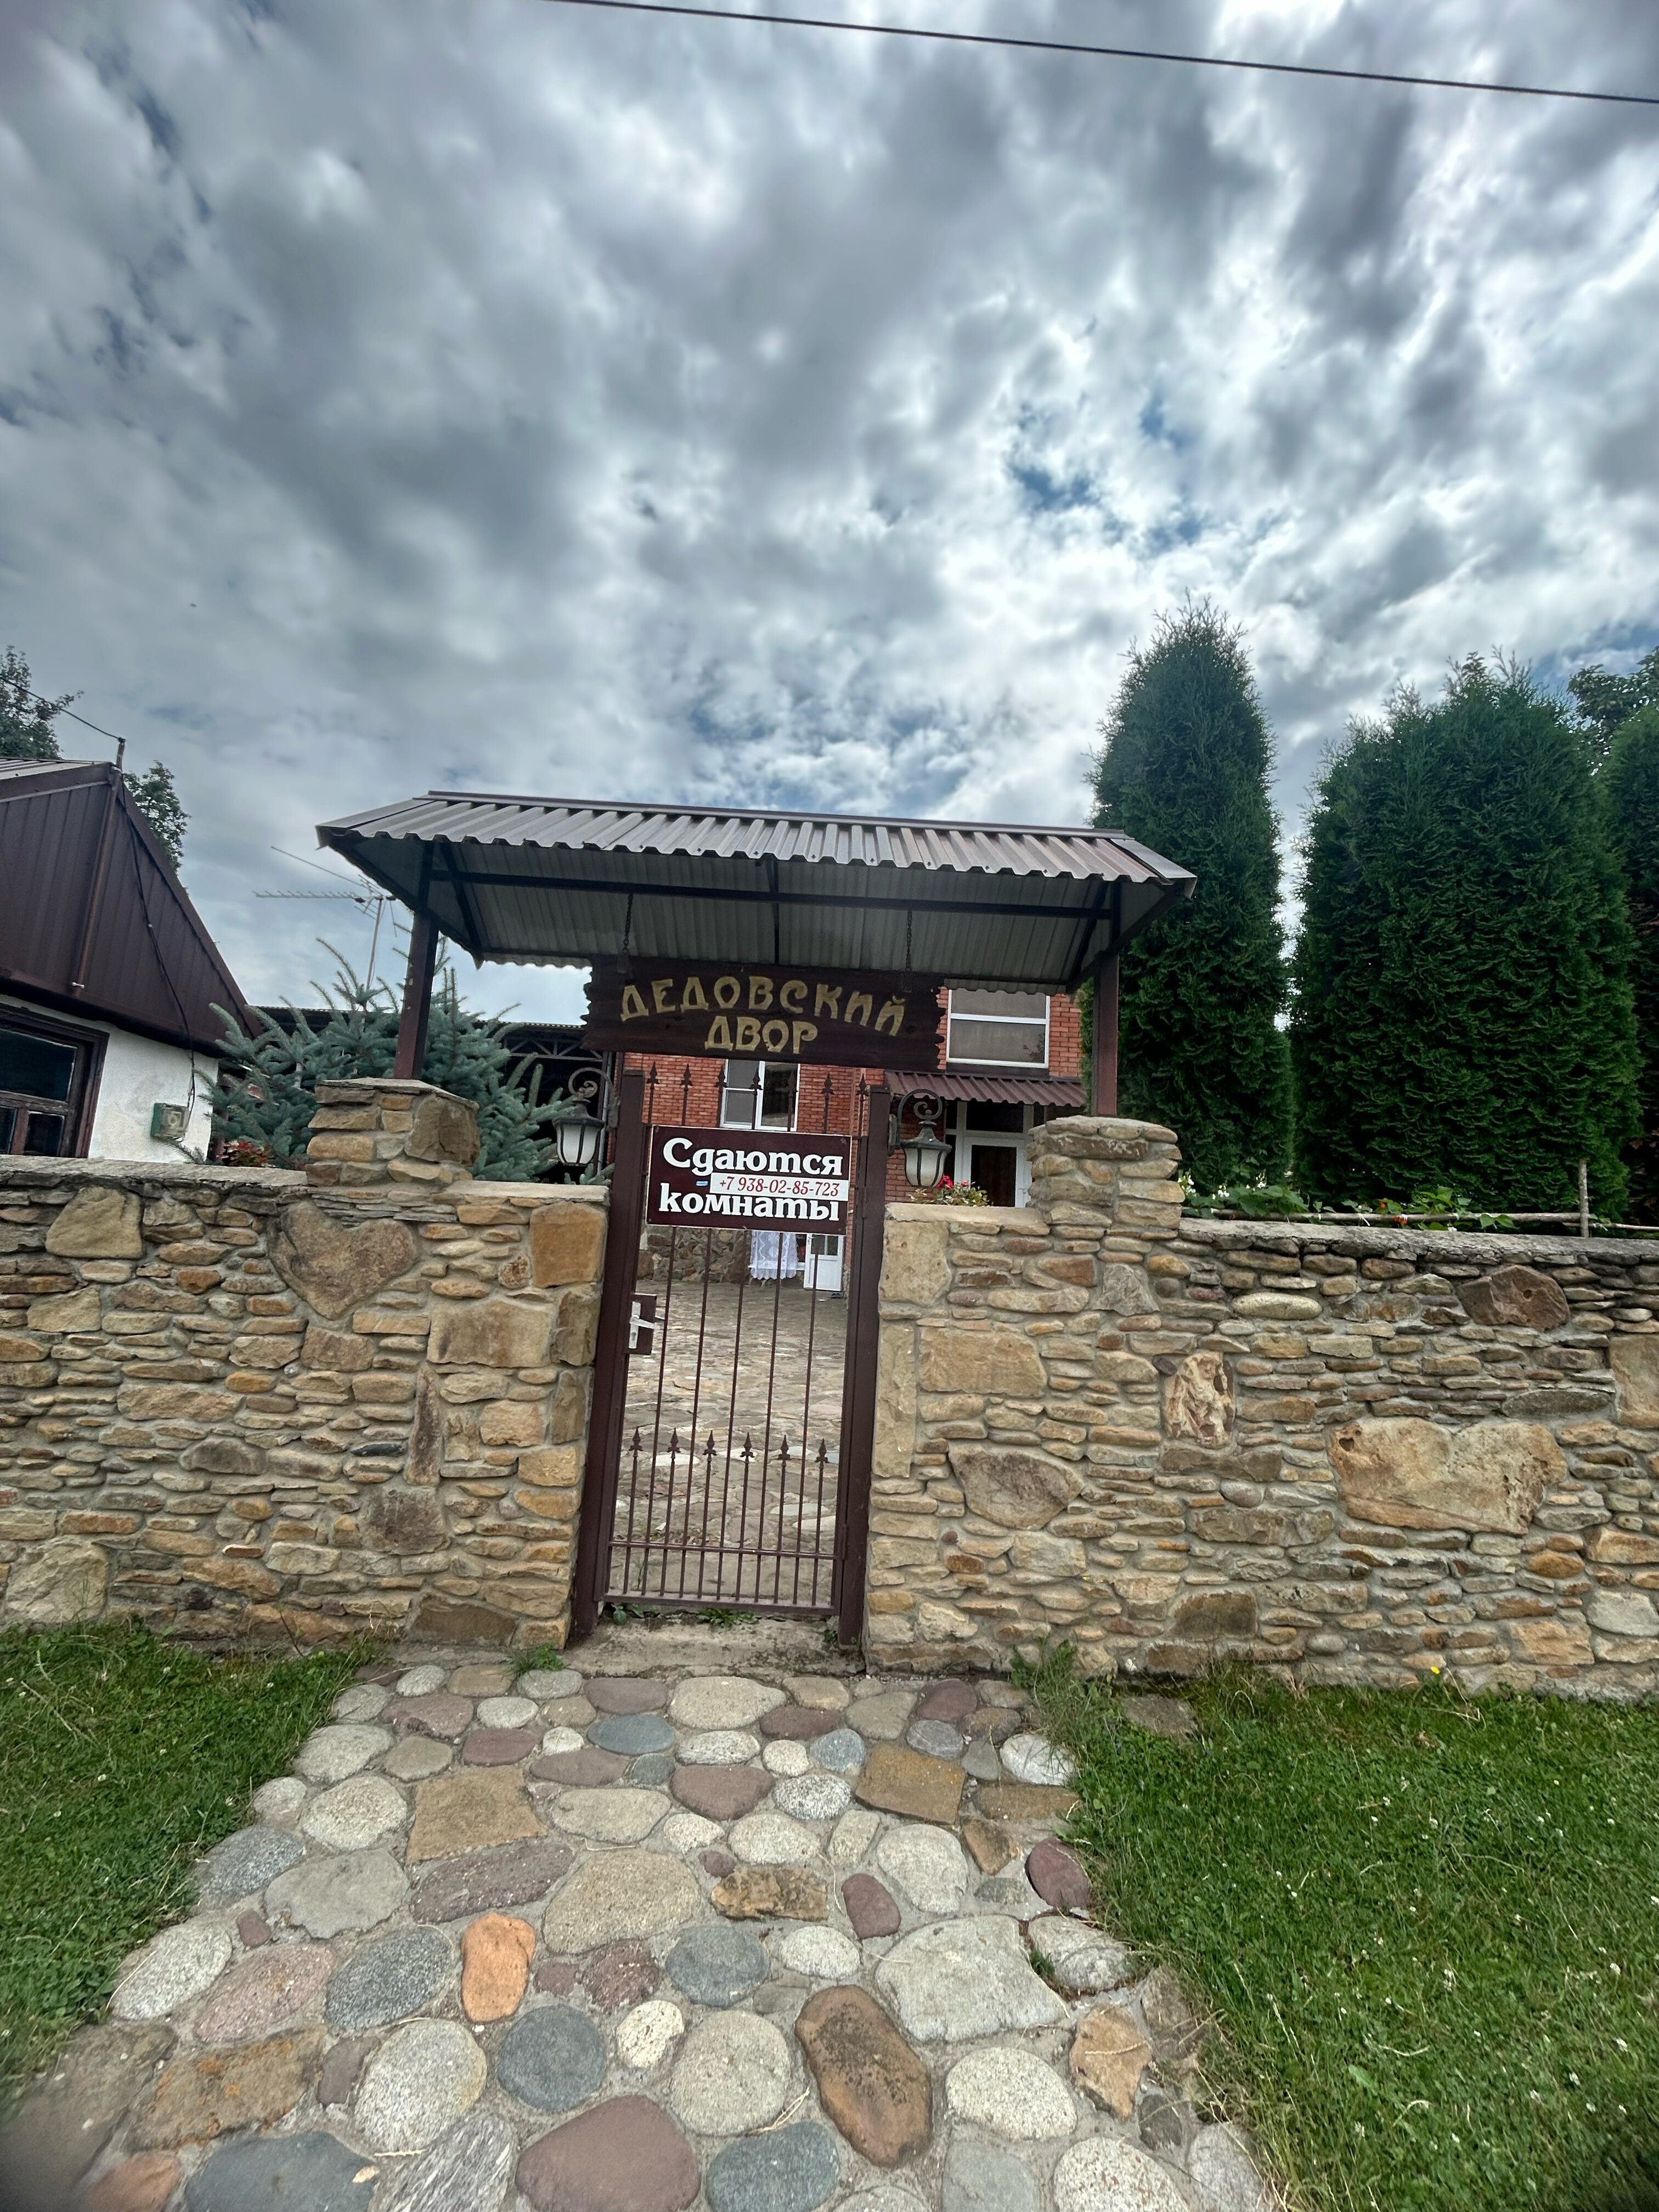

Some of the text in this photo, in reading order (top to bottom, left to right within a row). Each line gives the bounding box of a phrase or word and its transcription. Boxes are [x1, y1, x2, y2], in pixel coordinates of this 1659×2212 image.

[620, 976, 905, 1036] ДЕДОВСКИЙ
[704, 1015, 817, 1054] ДВОР
[663, 1137, 843, 1176] Сдаются
[658, 1182, 839, 1221] комнаты
[719, 1176, 840, 1197] +7 938-02-85-723
